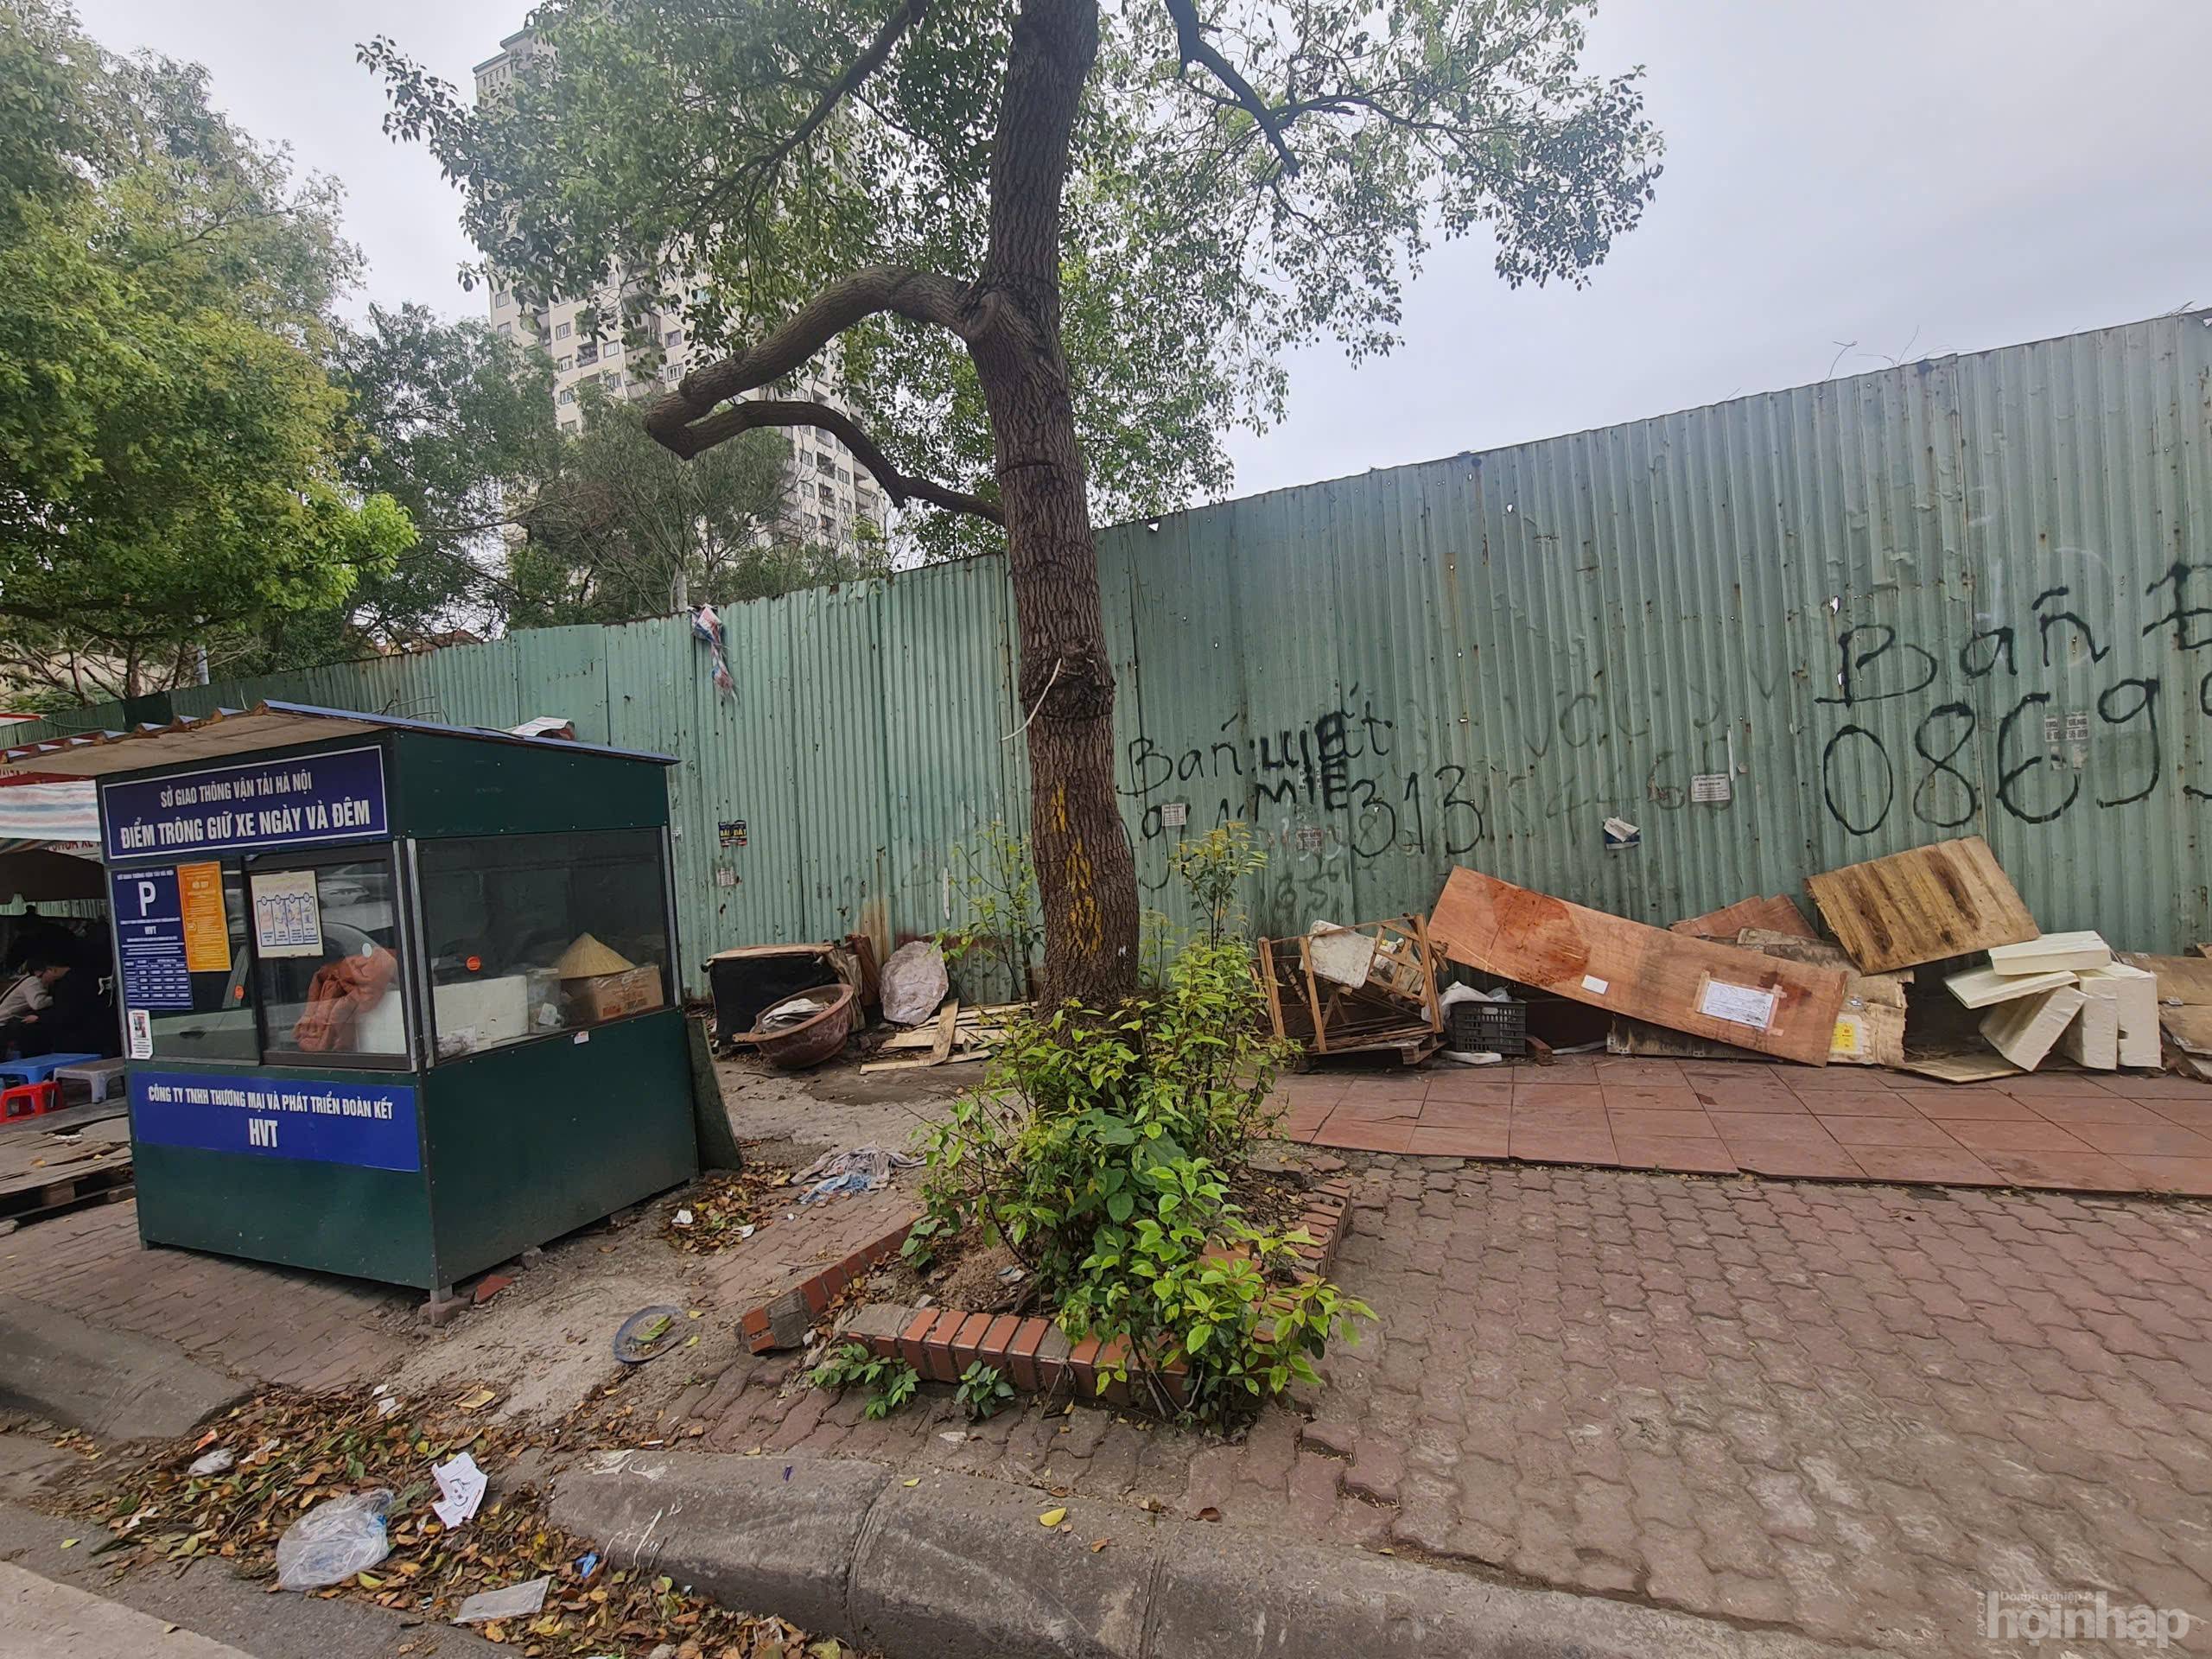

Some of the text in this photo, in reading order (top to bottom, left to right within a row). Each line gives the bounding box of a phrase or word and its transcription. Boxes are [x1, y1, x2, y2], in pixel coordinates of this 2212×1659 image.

[161, 768, 312, 808] SỞ GIAO THÔNG VẬN TẢI HÀ NỘI
[120, 796, 371, 849] ĐIỂM TRÔNG GIỮ XE NGÀY VÀ ĐÊM
[138, 881, 156, 916] P
[148, 1084, 393, 1120] CÔNG TY TNHH THƯƠNG MẠI VÀ PHÁT TRIỂN ĐOÀN KẾT
[249, 1118, 277, 1148] HVT
